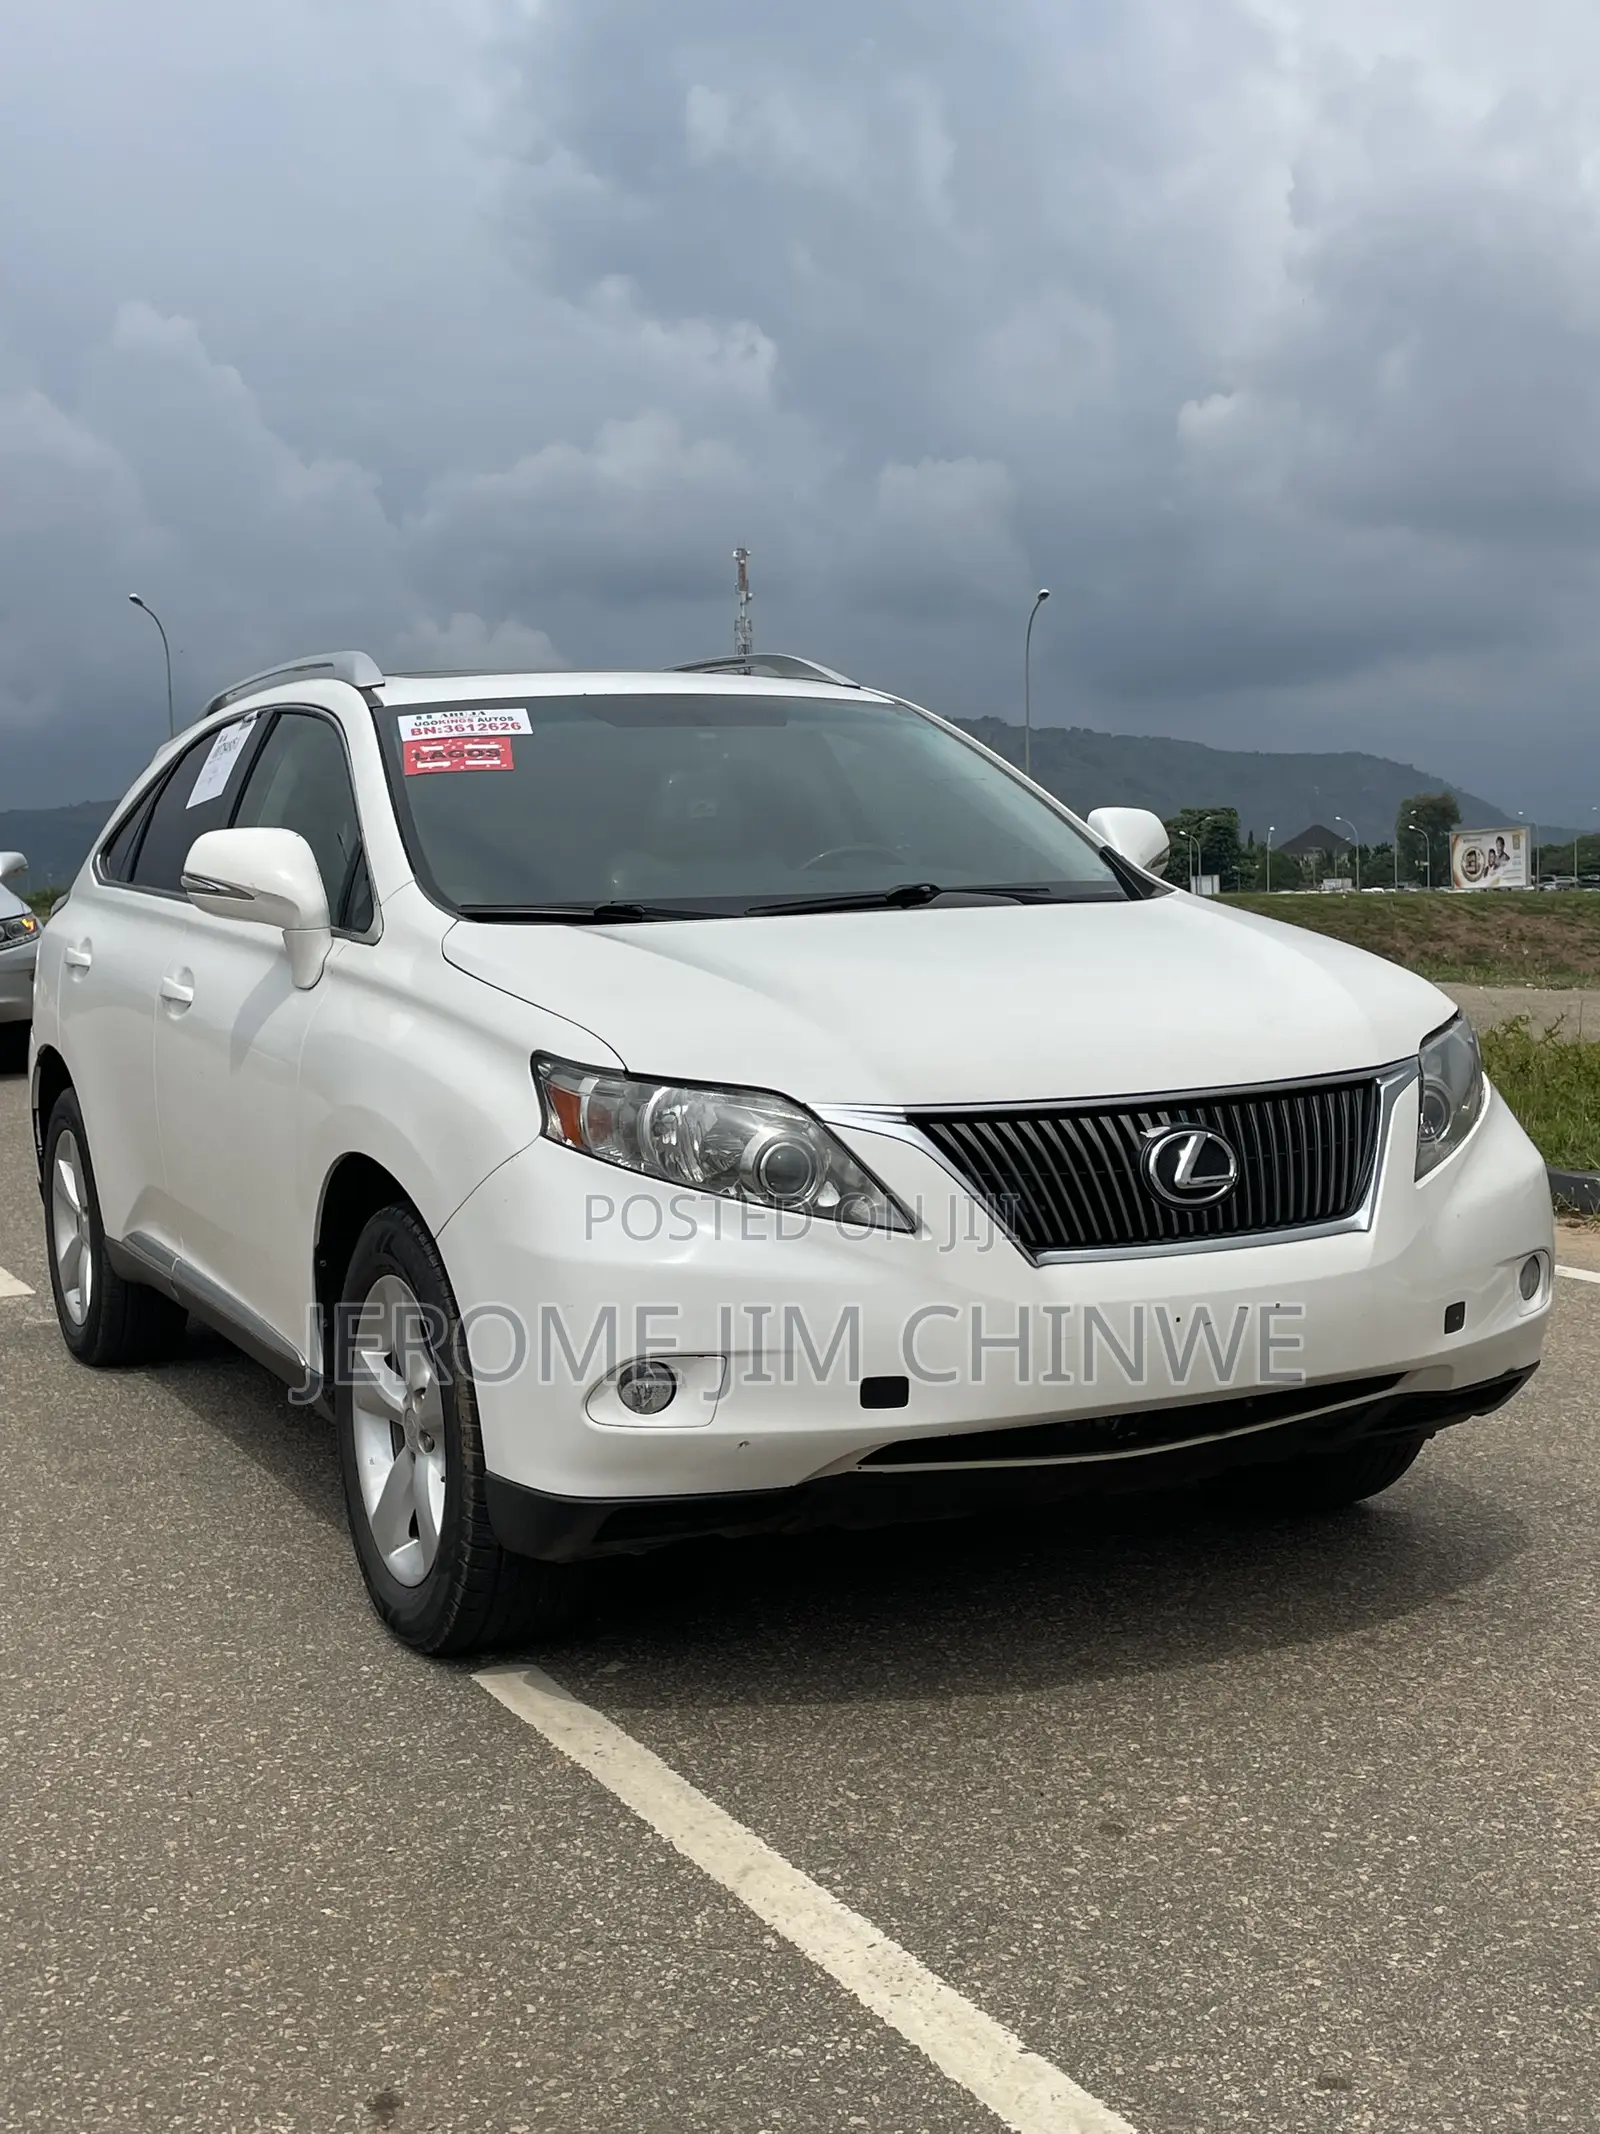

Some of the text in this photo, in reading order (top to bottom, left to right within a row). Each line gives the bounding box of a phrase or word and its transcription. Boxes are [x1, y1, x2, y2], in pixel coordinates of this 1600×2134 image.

[477, 715, 514, 723] AUTOS
[410, 722, 522, 736] BN:3612626
[413, 748, 501, 761] LAGOS
